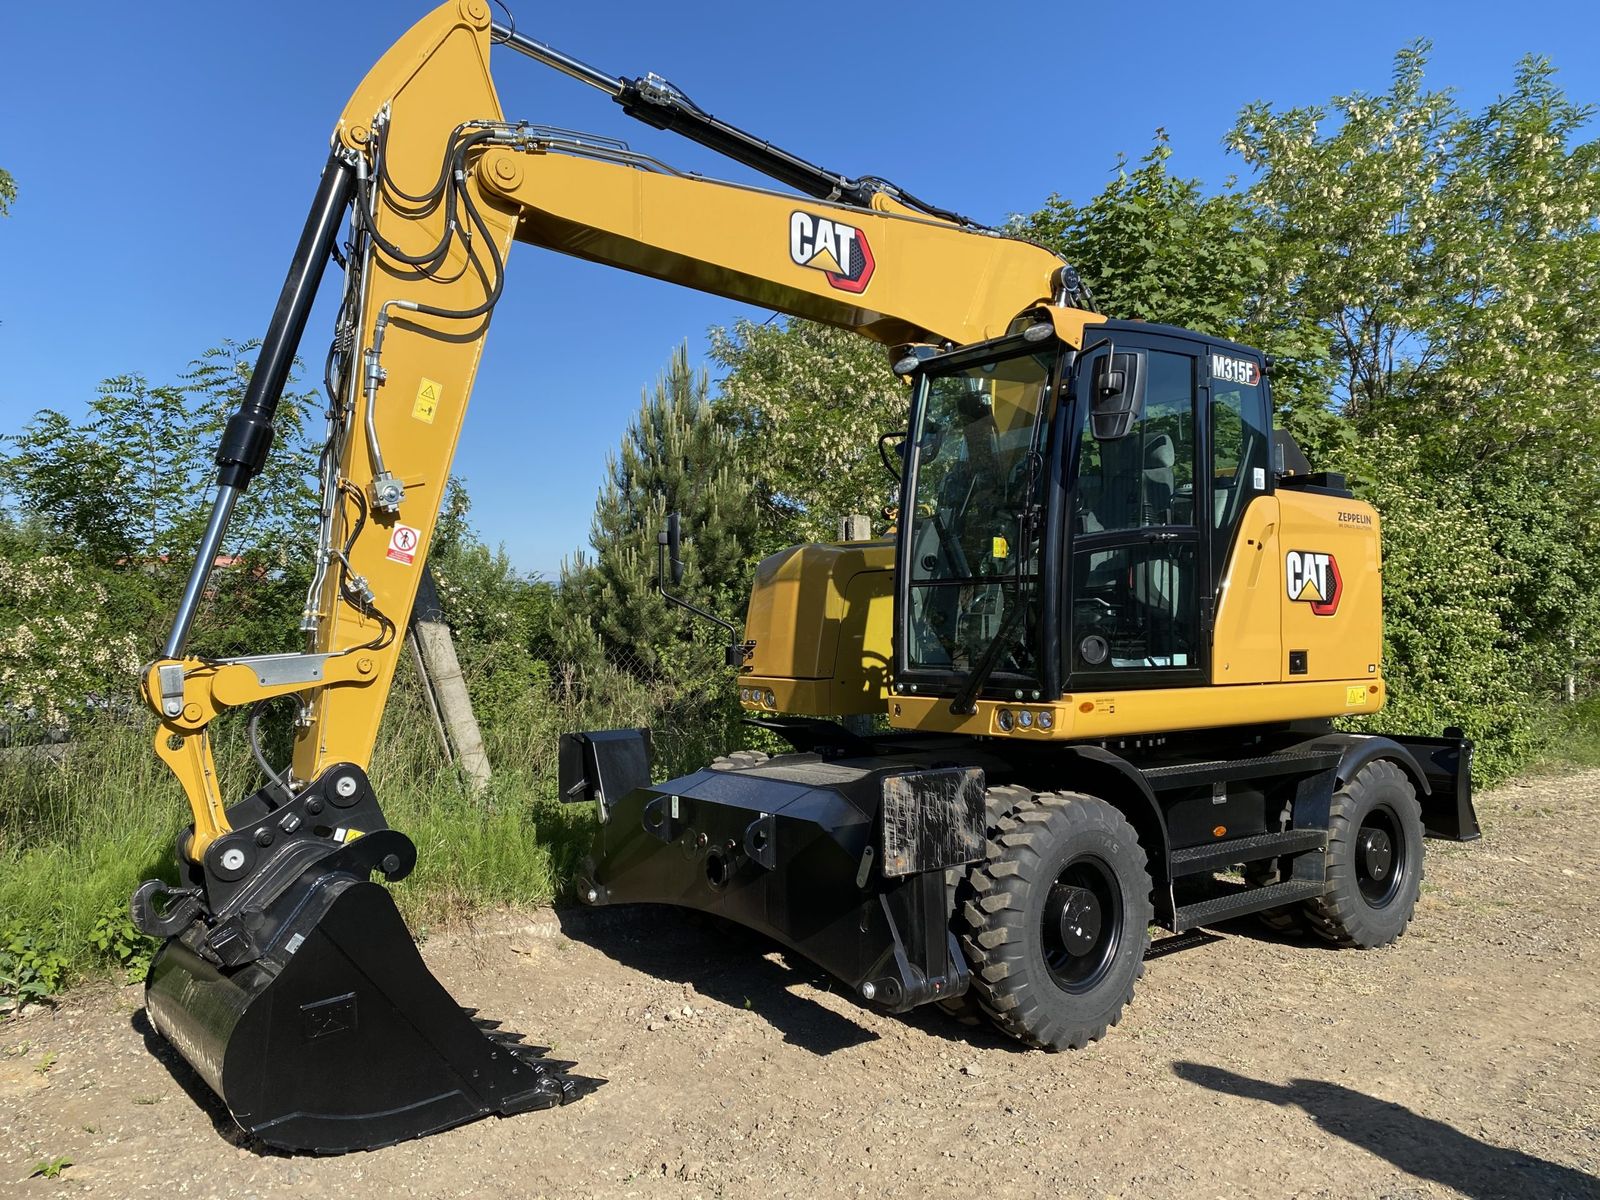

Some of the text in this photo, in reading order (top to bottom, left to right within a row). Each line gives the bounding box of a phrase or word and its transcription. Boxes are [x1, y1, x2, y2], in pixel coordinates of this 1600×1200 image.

[790, 210, 856, 277] CAT
[1212, 355, 1253, 383] M315F
[1338, 511, 1372, 525] ZEPPELIN
[1286, 550, 1330, 601] CAT
